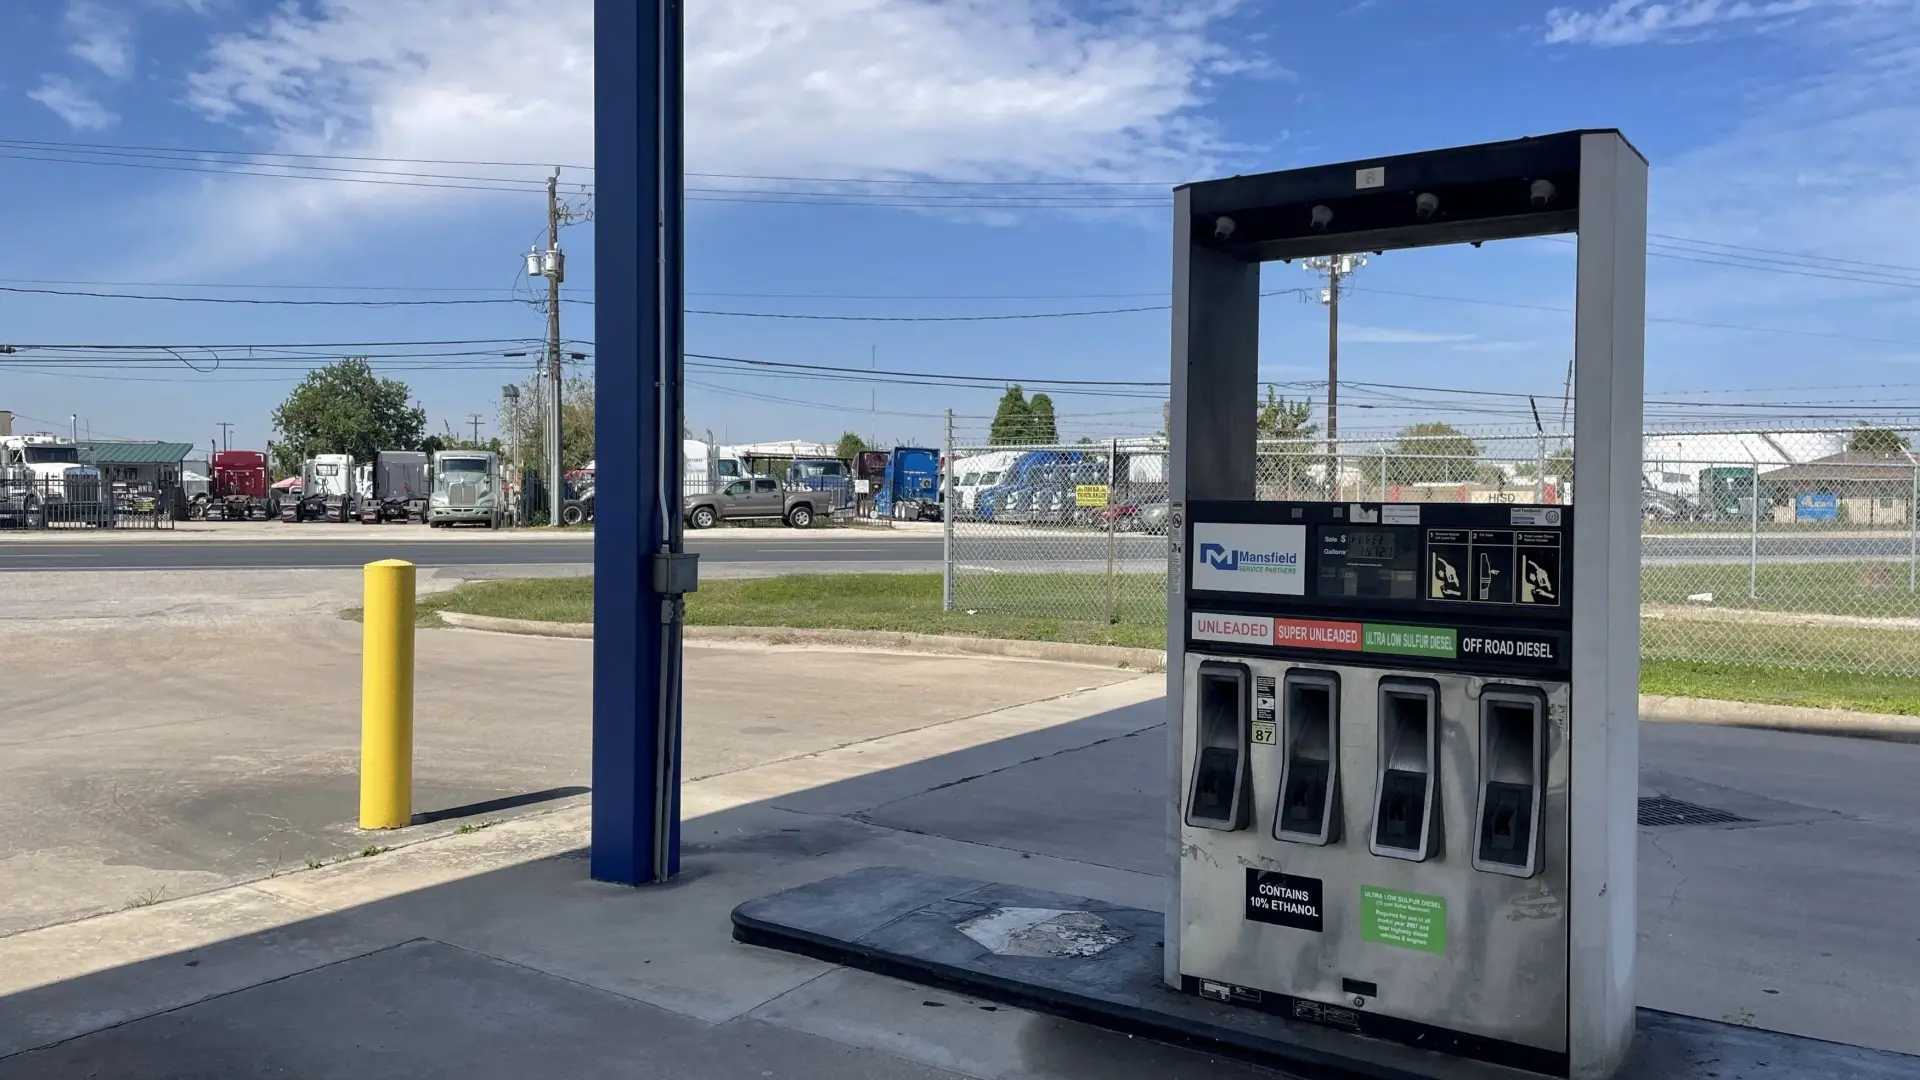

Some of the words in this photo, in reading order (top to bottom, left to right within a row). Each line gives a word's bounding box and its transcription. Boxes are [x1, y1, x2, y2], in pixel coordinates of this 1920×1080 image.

[1324, 535, 1338, 543] Sale
[1341, 534, 1347, 543] $
[1239, 551, 1297, 564] Mansfield
[1239, 565, 1263, 573] SERVICE
[1264, 566, 1297, 574] PARTNERS
[1197, 619, 1268, 637] UNLEADED
[1278, 625, 1307, 640] SUPER
[1309, 628, 1358, 644] UNLEADED
[1365, 631, 1386, 645] ULTRA
[1387, 633, 1402, 647] LOW
[1402, 633, 1429, 649] SULFUR
[1430, 635, 1453, 650] DIESEL
[1463, 637, 1483, 653] OFF
[1485, 639, 1514, 656] ROAD
[1516, 641, 1554, 658] DIESEL
[1256, 729, 1272, 742] 87
[1259, 884, 1309, 901] CONTAINS
[1364, 891, 1383, 899] ULTRA
[1397, 896, 1420, 905] SULFUR
[1421, 900, 1441, 908] DIESEL
[1250, 896, 1269, 909] 10%
[1271, 899, 1319, 917] ETHANOL
[1376, 909, 1398, 918] Required
[1380, 933, 1400, 941] vehicles
[1406, 937, 1427, 945] engines
